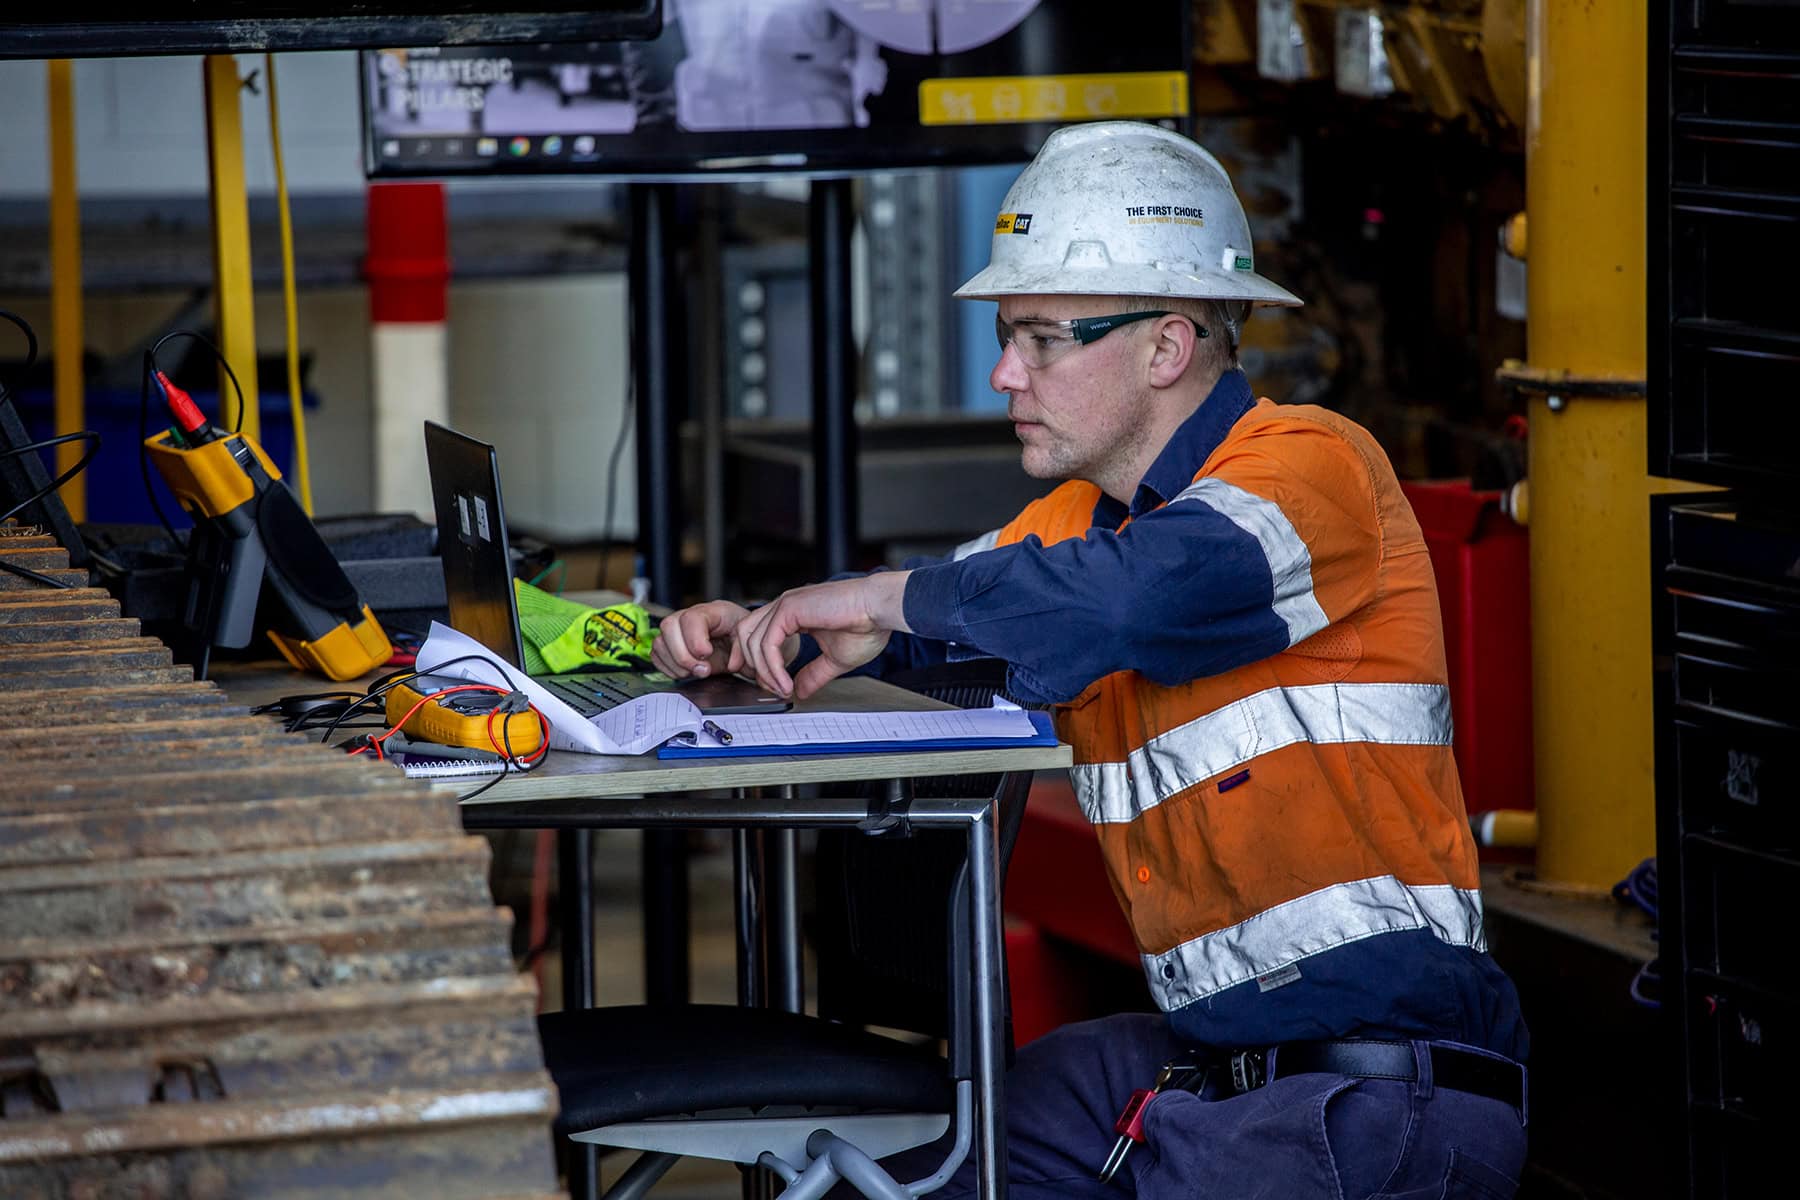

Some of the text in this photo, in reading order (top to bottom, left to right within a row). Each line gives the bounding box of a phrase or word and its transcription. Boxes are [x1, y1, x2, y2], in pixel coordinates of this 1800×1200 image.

[1126, 206, 1204, 219] THE FIRST CHOICE
[1015, 217, 1030, 230] CAT
[1174, 217, 1204, 228] SOLUTIONS
